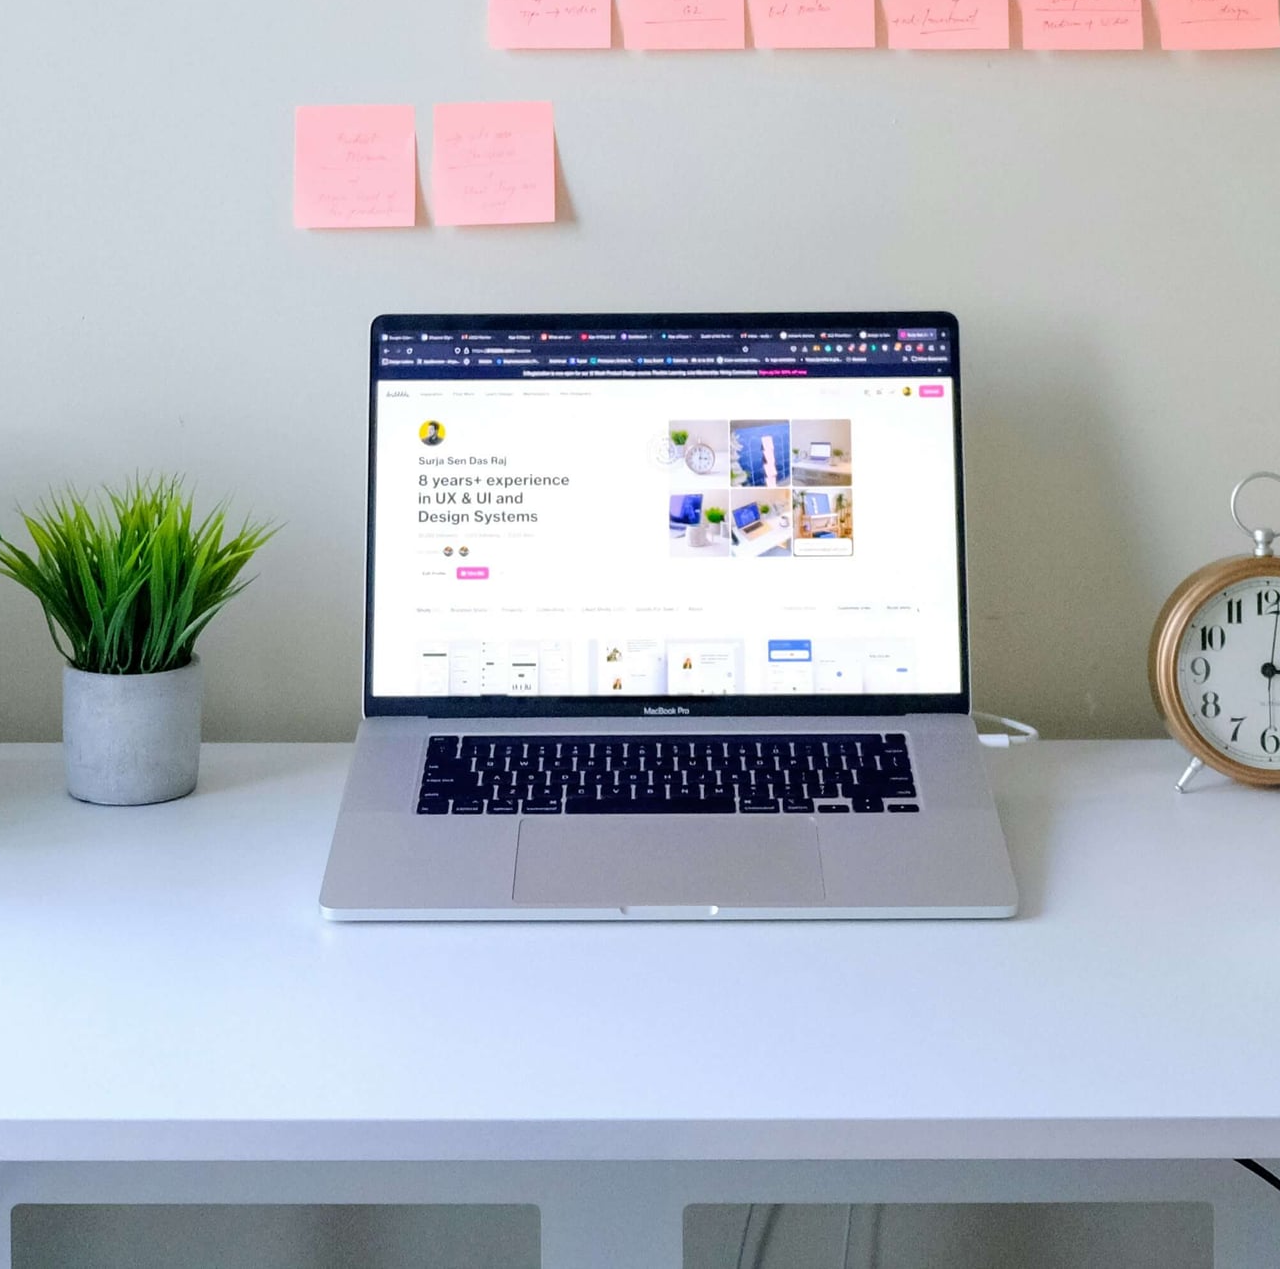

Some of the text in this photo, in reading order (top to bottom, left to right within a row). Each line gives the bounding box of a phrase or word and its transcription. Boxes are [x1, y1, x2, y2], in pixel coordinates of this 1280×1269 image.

[418, 456, 508, 467] Surja Sen Das Raj
[418, 473, 570, 489] 8 years+ experience
[418, 491, 524, 505] in UX & UI and
[418, 509, 539, 526] Design Systems
[1225, 598, 1243, 624] 11
[1199, 624, 1226, 651] 10
[1190, 656, 1211, 684] 9
[643, 706, 690, 715] MacBook Pro
[1200, 692, 1222, 719] 8
[1228, 717, 1245, 742] 7
[1259, 726, 1280, 755] 6
